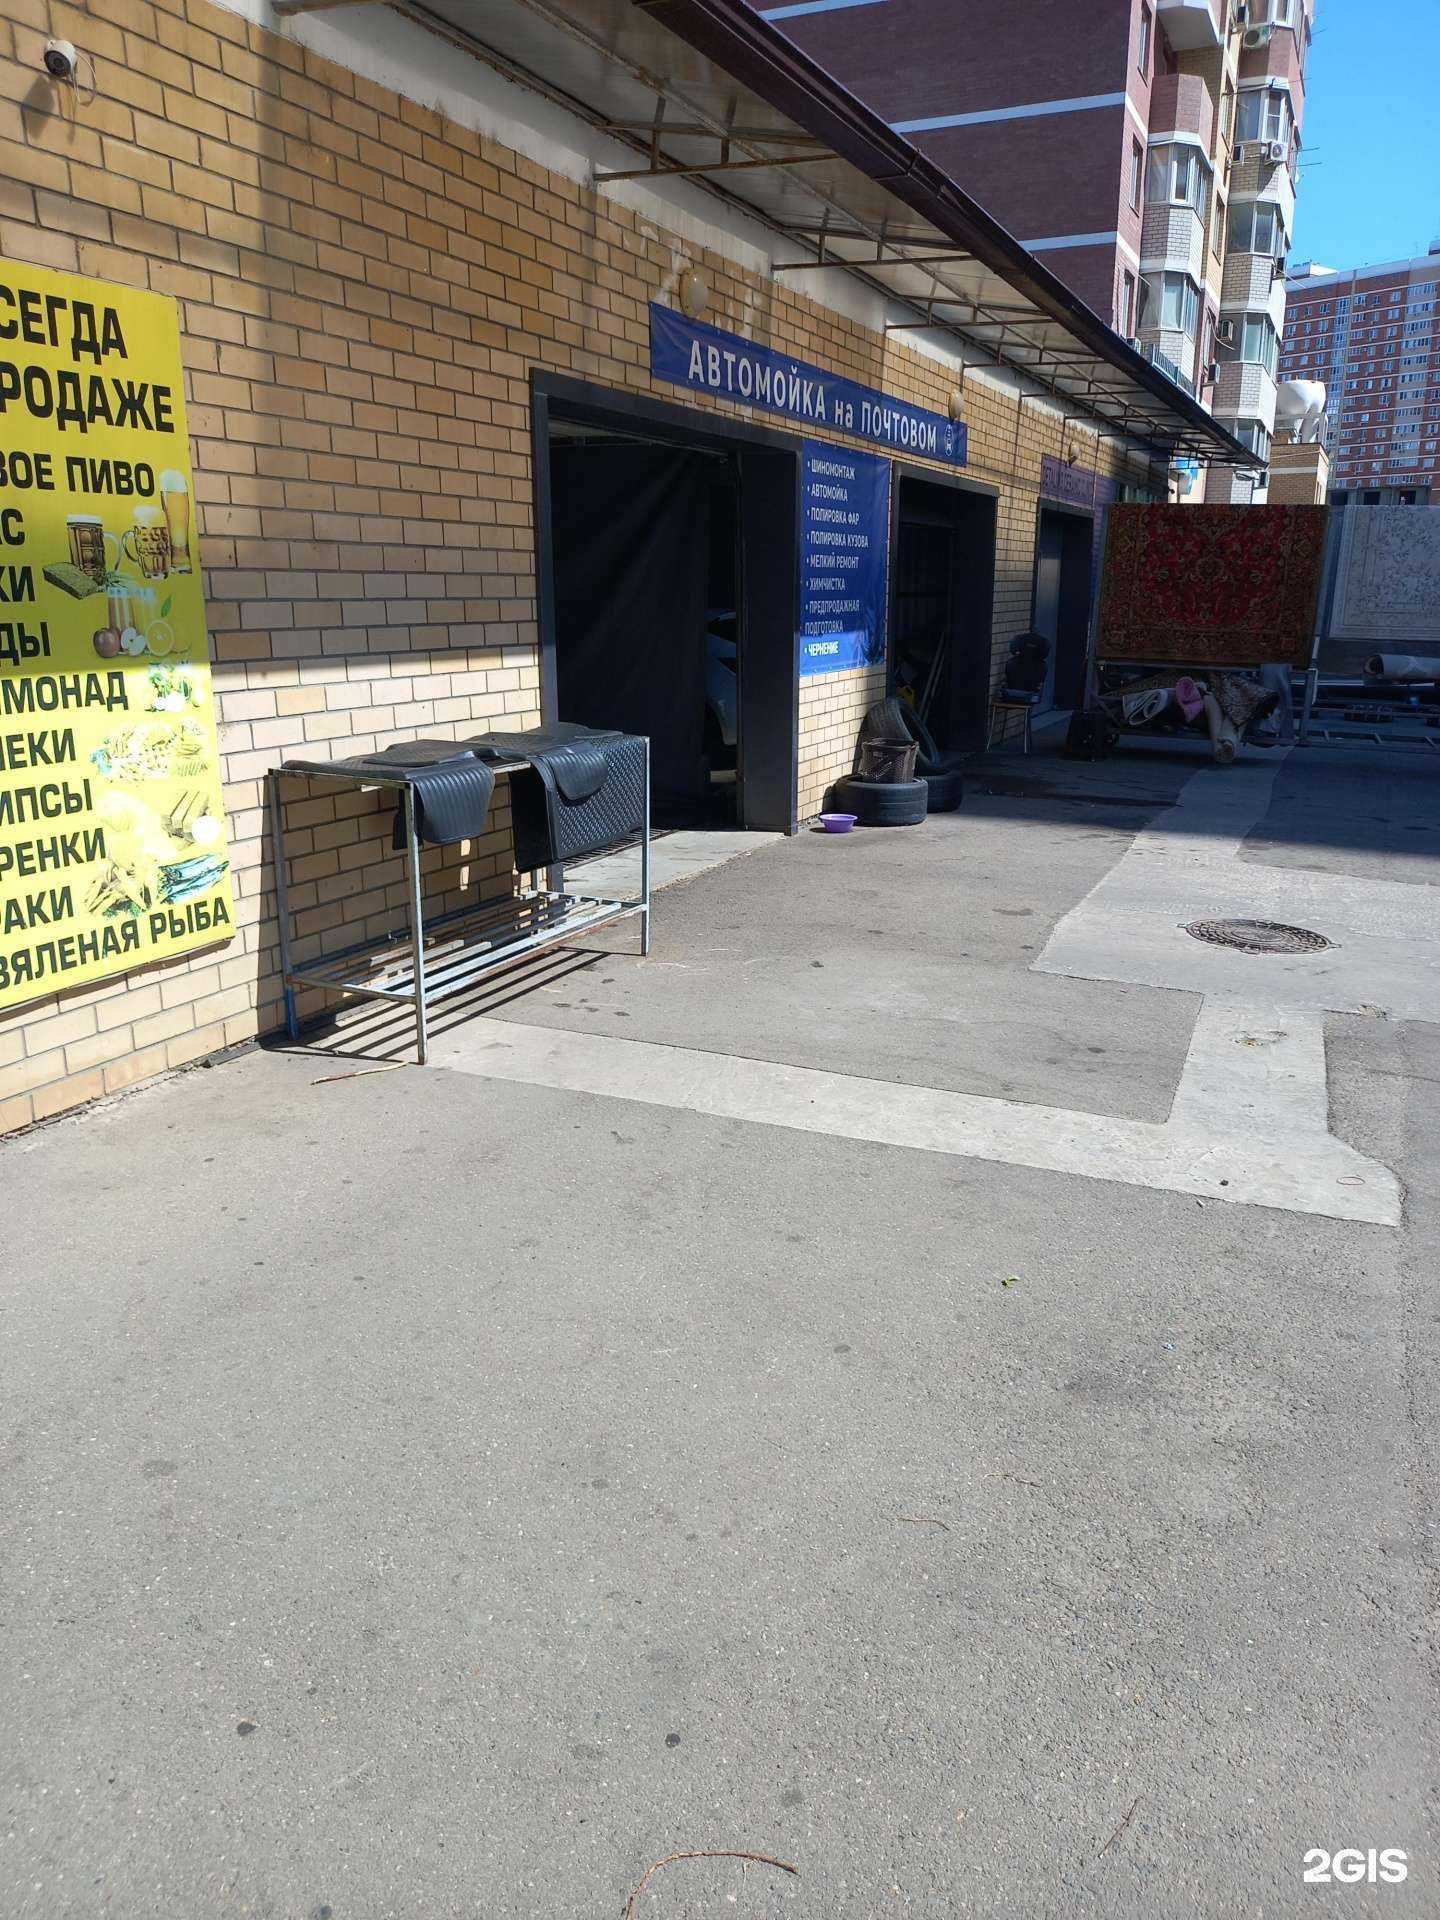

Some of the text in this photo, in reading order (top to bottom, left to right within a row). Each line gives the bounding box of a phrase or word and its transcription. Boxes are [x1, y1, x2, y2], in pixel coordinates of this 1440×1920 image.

[0, 284, 128, 365] СЕГДА
[0, 361, 175, 433] РОДАЖЕ
[688, 340, 937, 453] АВТОМОЙКА на ПОЧТОВОМ
[66, 456, 155, 497] ПИВО
[811, 458, 856, 480] ШИНОМОНТАЖ
[811, 483, 848, 502] АВТОМОЙКА
[811, 507, 860, 526] ПОЛИРОВКА ФАР
[811, 531, 869, 548] ПОЛИРОВКА КУЗОВА
[810, 552, 859, 568] МЕЛКИЙ РЕМОНТ
[809, 578, 846, 591] ХИМЧИСТКА
[809, 600, 860, 615] ПРЕДПРОДАЖНАЯ
[805, 621, 843, 636] ПОДГОТОВКА
[808, 641, 839, 656] ЧЕРНЕНИЕ
[0, 728, 77, 771] ЕКИ
[149, 896, 230, 945] РЫБА
